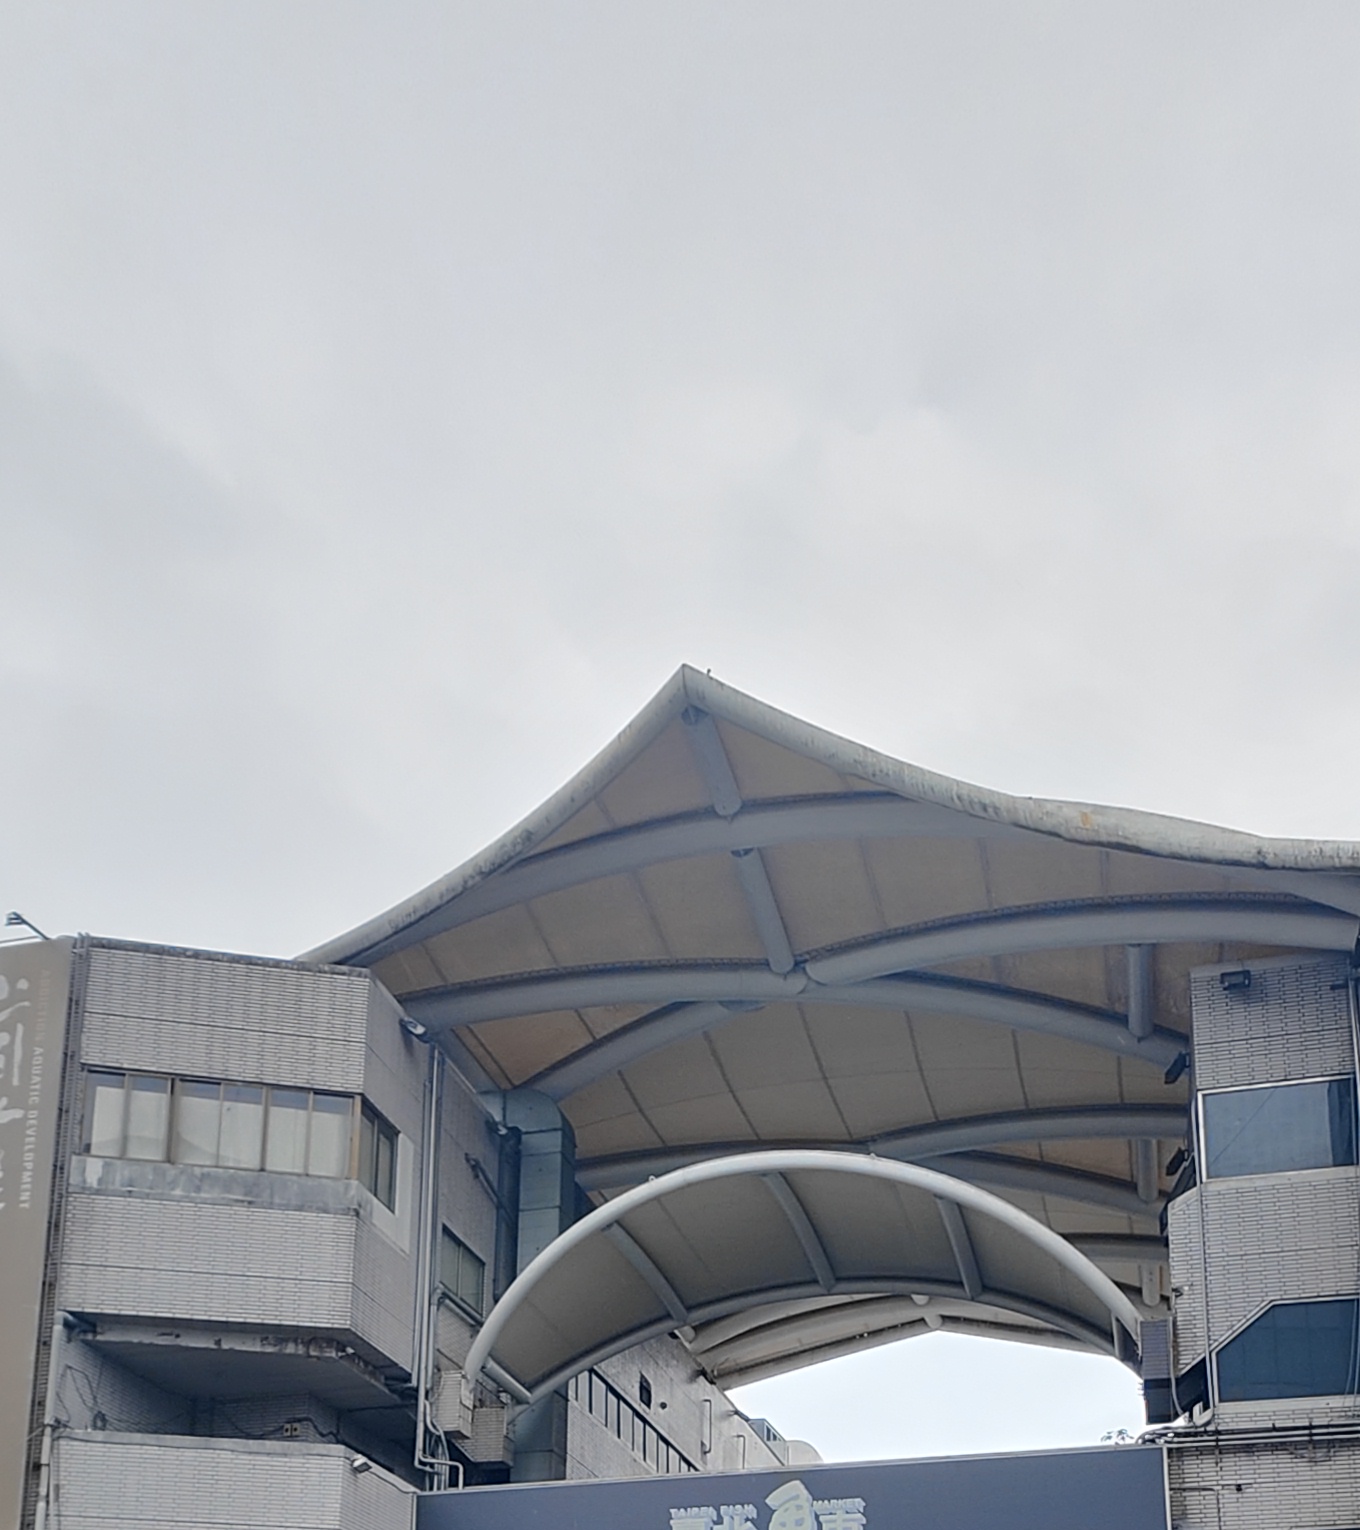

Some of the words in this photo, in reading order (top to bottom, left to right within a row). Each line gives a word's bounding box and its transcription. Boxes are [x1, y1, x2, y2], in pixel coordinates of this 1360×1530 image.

[27, 1046, 44, 1105] AQUATIC
[18, 1110, 39, 1209] DEVELOPMENT
[669, 1507, 717, 1521] TAIPEI
[720, 1504, 758, 1519] FISH
[813, 1498, 866, 1513] MARKET
